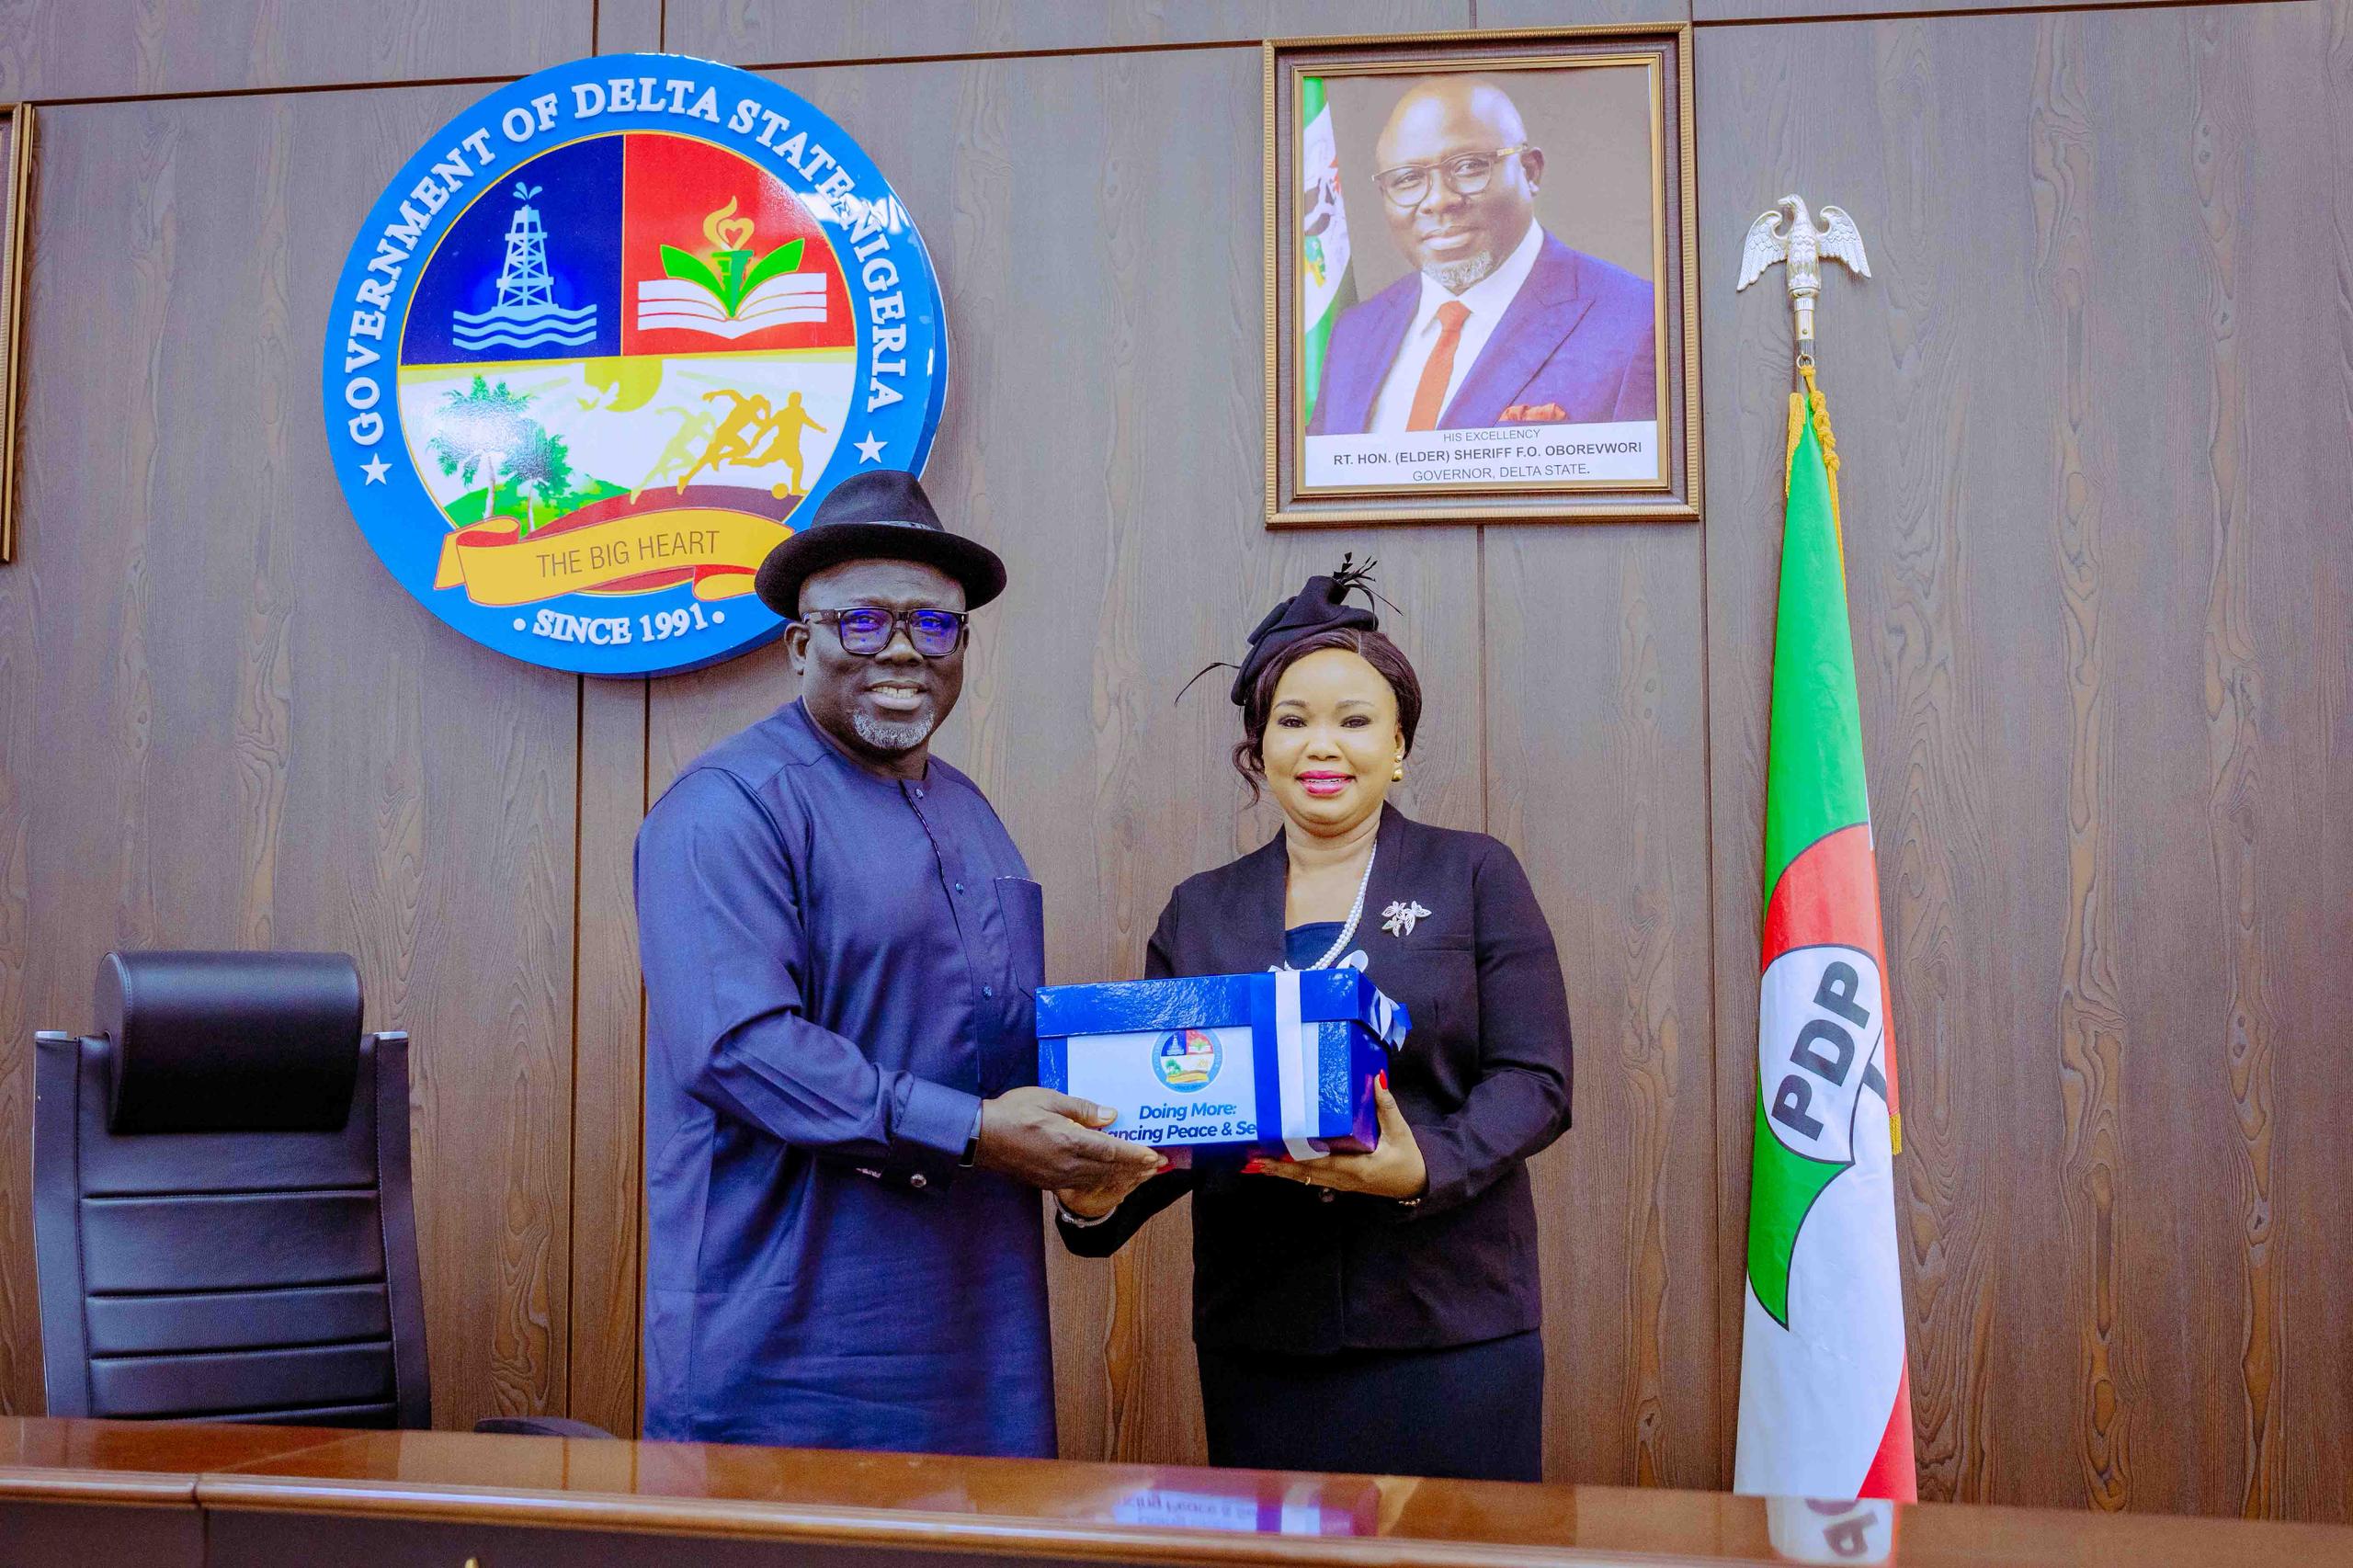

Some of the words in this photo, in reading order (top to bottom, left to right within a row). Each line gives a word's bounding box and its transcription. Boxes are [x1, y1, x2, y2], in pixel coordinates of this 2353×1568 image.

[345, 127, 496, 447] GOVERNMENT
[502, 93, 558, 142] OF
[572, 77, 721, 123] DELTA
[728, 98, 856, 199] STATE
[840, 193, 907, 414] NIGERIA
[1443, 432, 1462, 443] HIS
[1466, 428, 1540, 442] EXCELLENCY
[1334, 454, 1354, 465] RT.
[1358, 453, 1391, 464] HON.
[1395, 450, 1449, 465] (ELDER)
[1454, 447, 1512, 460] SHERIFF
[1517, 446, 1541, 458] F.O.
[1545, 442, 1642, 457] OBOREVWORI
[1413, 467, 1495, 482] GOVERNOR,
[1500, 465, 1541, 478] DELTA
[1544, 463, 1590, 476] STATE.
[537, 550, 583, 578] THE
[590, 540, 630, 570] BIG
[638, 530, 720, 561] HEART
[532, 608, 631, 645] SINCE
[639, 603, 709, 642] 1991
[1770, 960, 1870, 1142] PDP
[1140, 1103, 1188, 1121] Doing
[1191, 1102, 1237, 1118] More:
[1166, 1124, 1218, 1140] Peace
[1221, 1121, 1233, 1136] &
